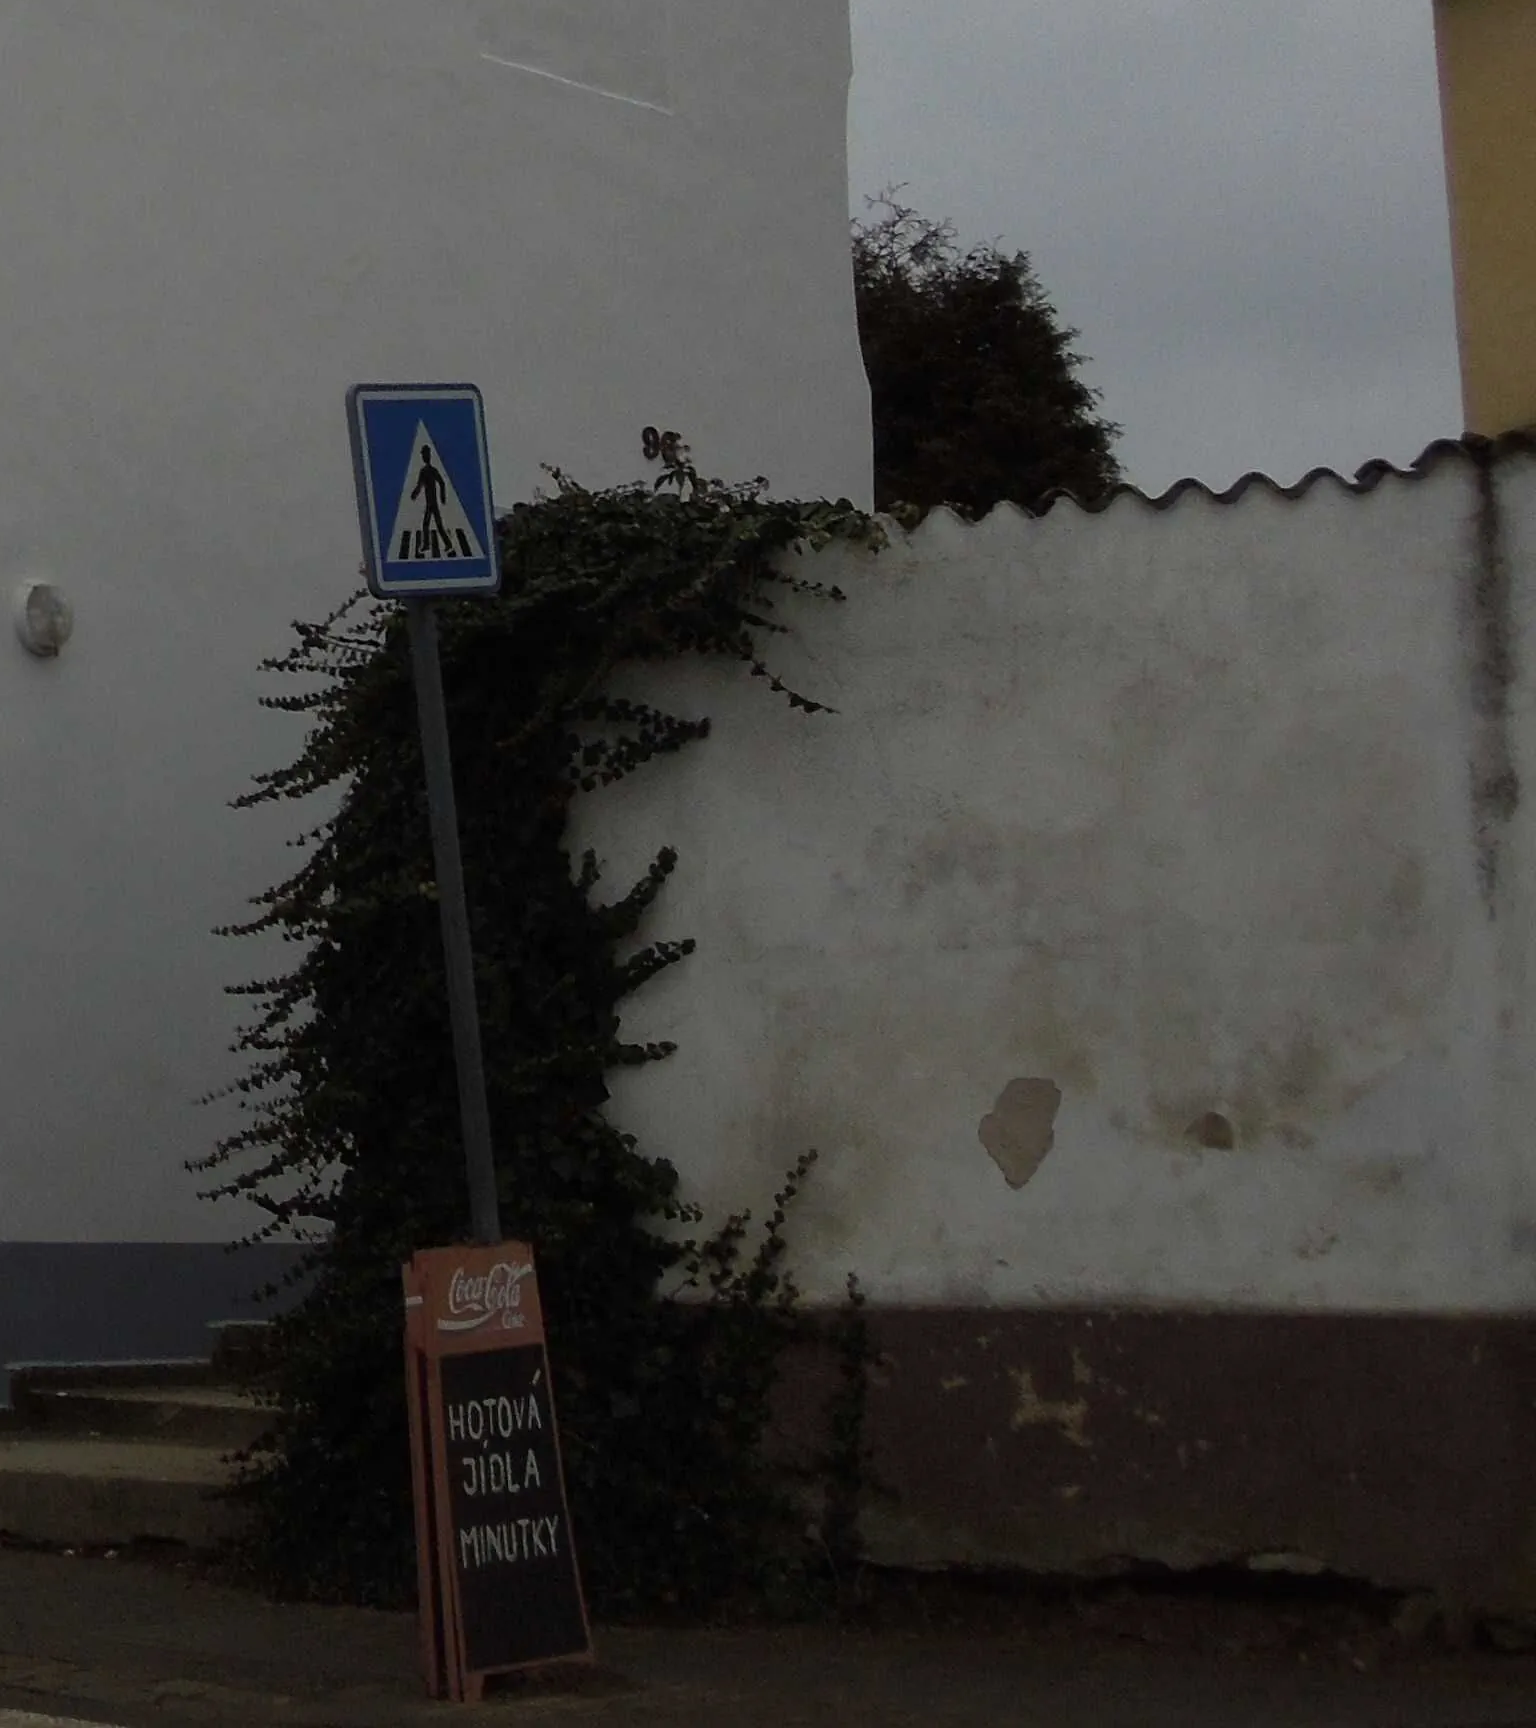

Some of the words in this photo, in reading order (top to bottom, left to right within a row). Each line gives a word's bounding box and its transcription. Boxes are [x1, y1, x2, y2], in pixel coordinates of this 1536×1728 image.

[448, 1368, 542, 1441] HOTOVÁ
[462, 1439, 541, 1496] JÍDLA
[459, 1516, 560, 1569] MINUTKY
